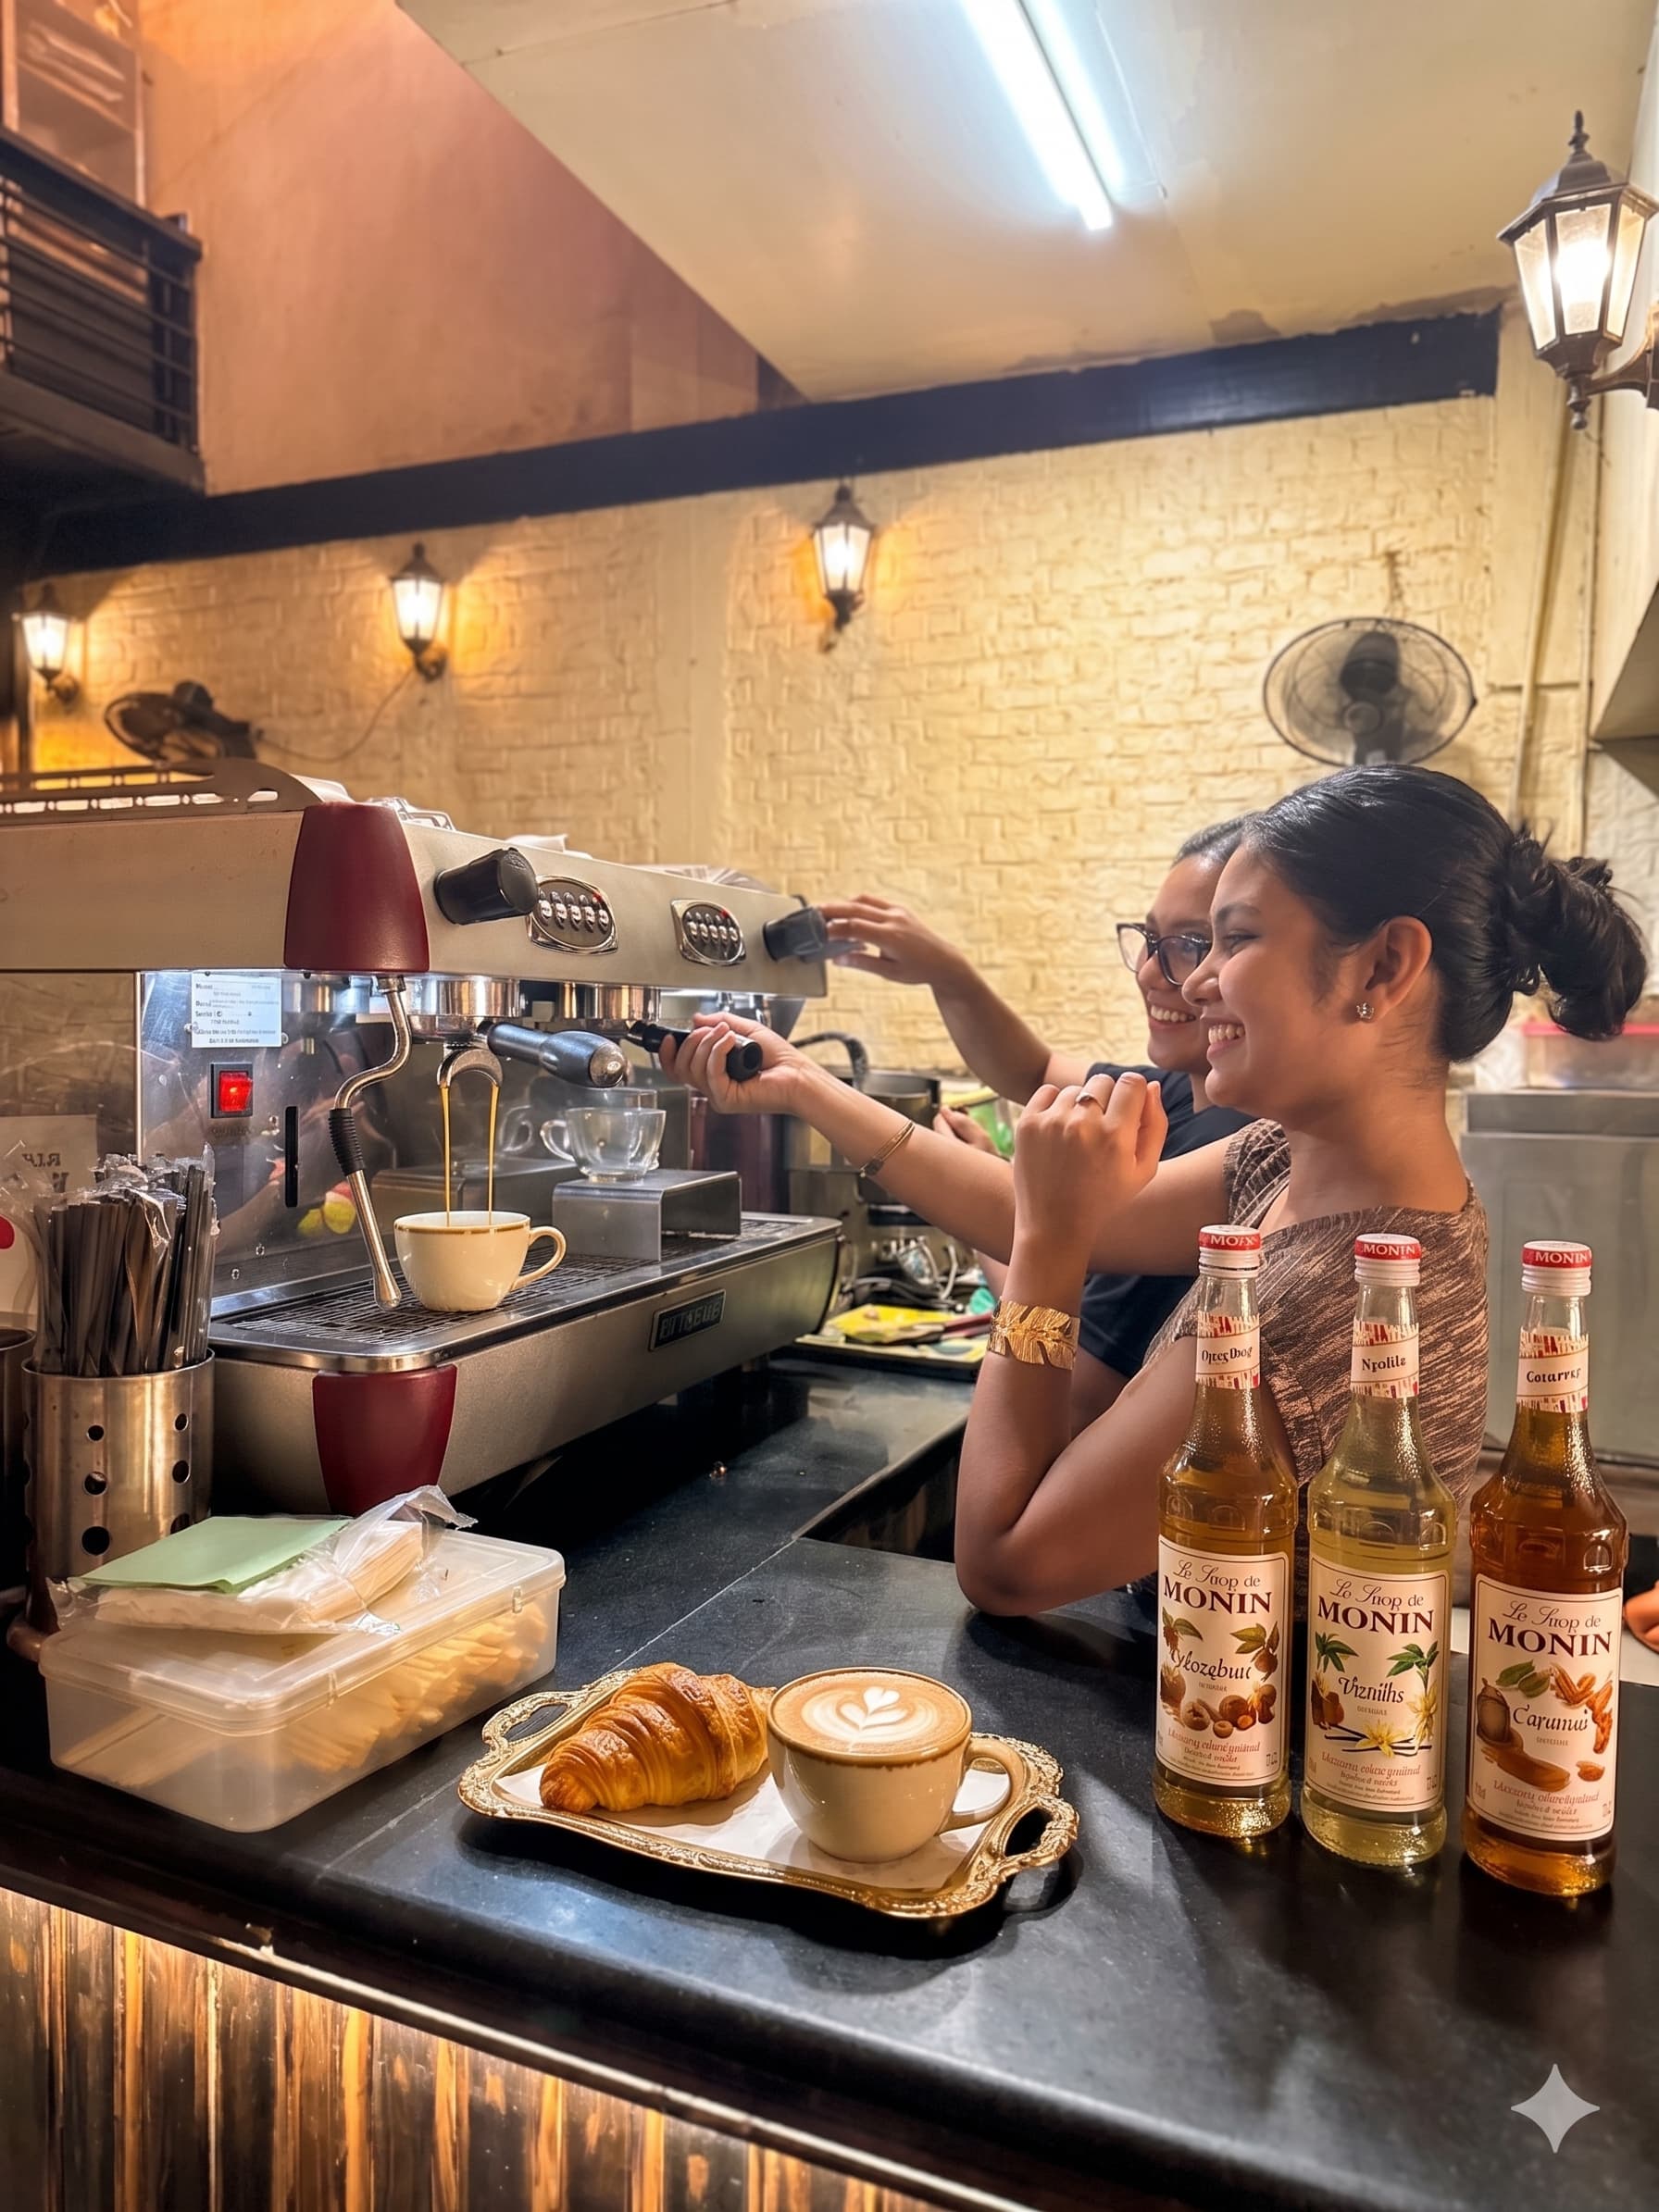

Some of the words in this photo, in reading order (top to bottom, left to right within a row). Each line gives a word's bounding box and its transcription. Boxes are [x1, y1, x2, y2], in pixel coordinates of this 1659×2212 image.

[1363, 1243, 1416, 1256] MONIN
[1535, 1252, 1589, 1264] MONIN
[1172, 1560, 1192, 1580] Le
[1243, 1575, 1261, 1588] de
[1163, 1575, 1272, 1615] MONIN
[1407, 1595, 1424, 1607] de
[1317, 1595, 1435, 1636] MONIN
[1502, 1600, 1528, 1622] Le
[1585, 1615, 1602, 1629] de
[1488, 1616, 1613, 1659] MONIN
